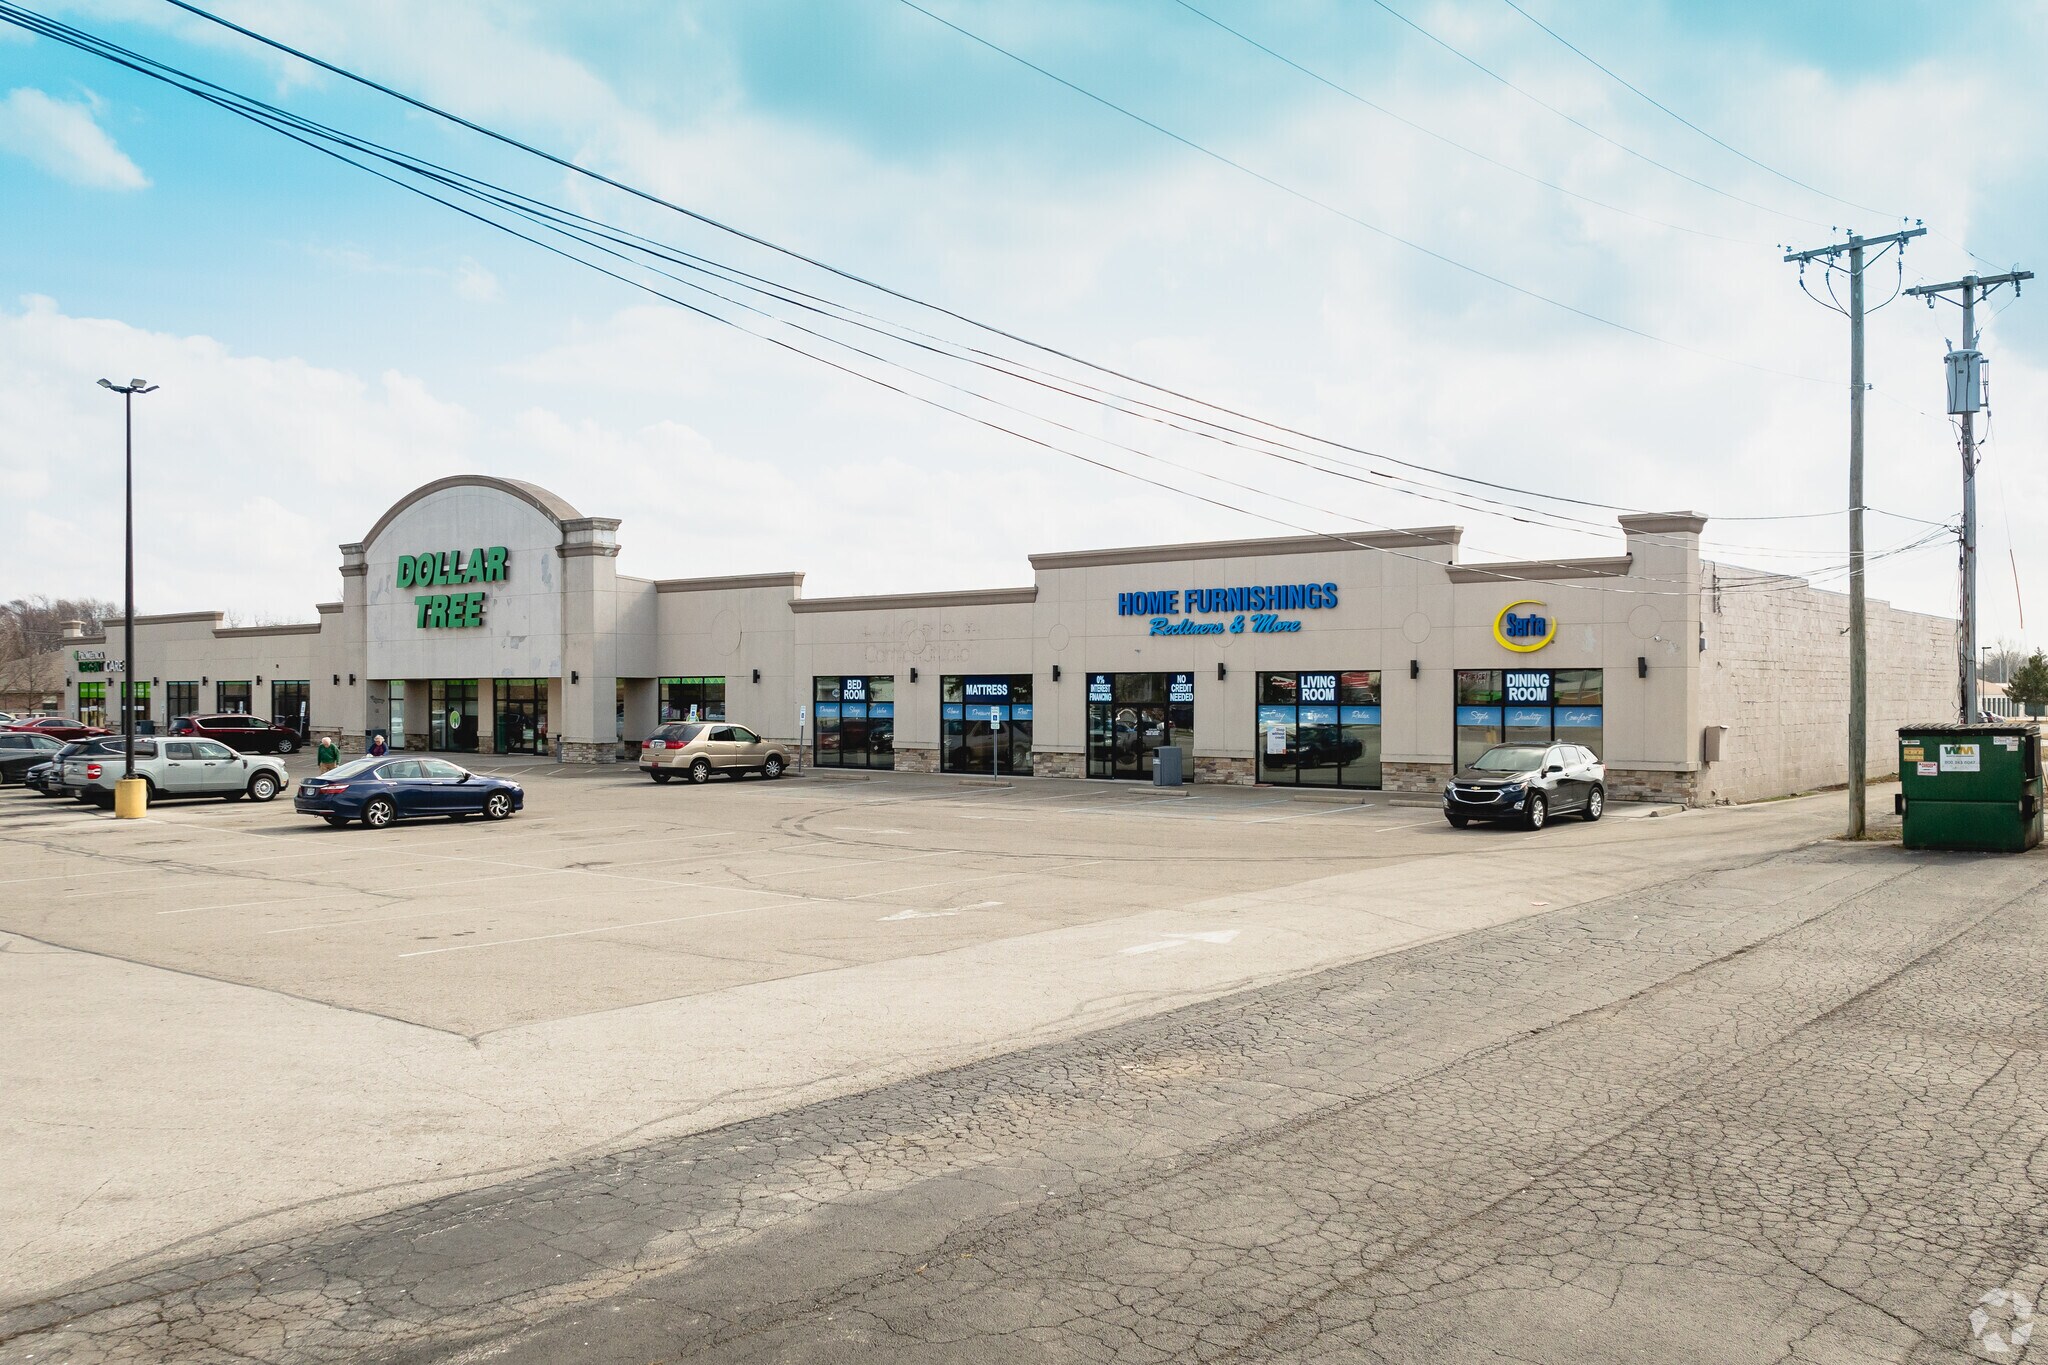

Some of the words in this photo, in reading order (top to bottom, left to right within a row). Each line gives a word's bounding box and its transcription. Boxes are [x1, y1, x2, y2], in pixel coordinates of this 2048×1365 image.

[396, 545, 509, 588] DOLLAR
[1118, 590, 1179, 616] HOME
[1184, 582, 1339, 613] FURNISHINGS
[414, 592, 486, 628] TREE
[1149, 616, 1225, 637] Recliners
[1229, 615, 1245, 634] &
[1250, 613, 1302, 633] More
[1506, 612, 1546, 637] Serta
[105, 660, 125, 672] CARE
[847, 679, 862, 690] BED
[1096, 675, 1105, 684] 0%
[1176, 674, 1187, 684] NO
[1300, 675, 1336, 688] LIVING
[1506, 673, 1550, 688] DINING
[965, 684, 1008, 696] MATTRESS
[1090, 684, 1111, 693] INTEREST
[1170, 683, 1193, 692] CREDIT
[1508, 687, 1547, 701] ROOM
[843, 689, 865, 700] ROOM
[1089, 693, 1112, 701] FINANCING
[1169, 693, 1194, 702] NEEDED
[1302, 688, 1335, 701] ROOM
[1470, 710, 1489, 724] Style
[1514, 711, 1545, 724] Quality
[1564, 711, 1599, 724] Comfort
[1944, 746, 1975, 755] WM
